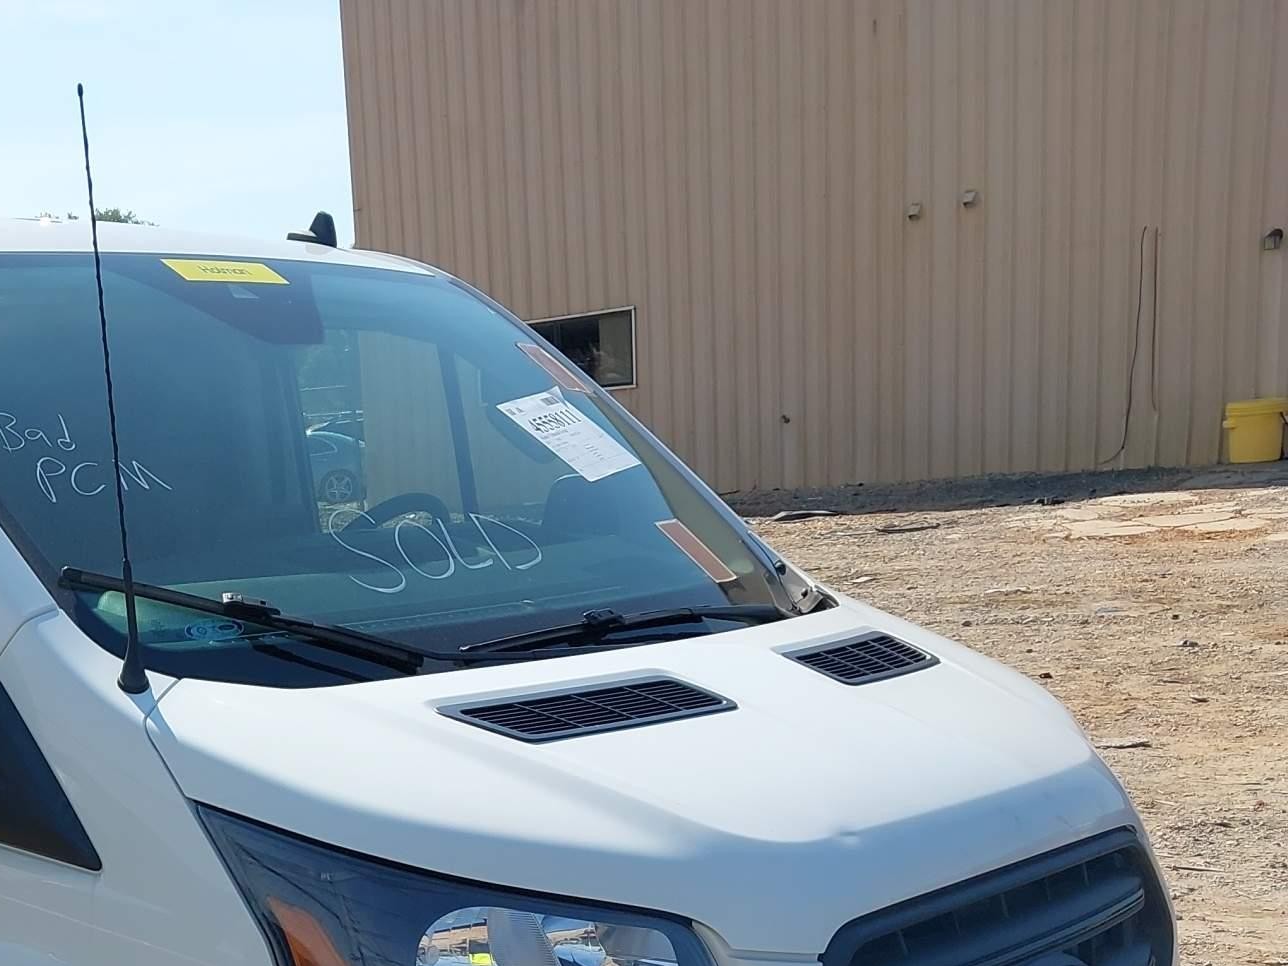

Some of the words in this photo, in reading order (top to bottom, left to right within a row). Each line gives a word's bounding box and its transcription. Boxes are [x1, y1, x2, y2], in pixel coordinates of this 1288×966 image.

[528, 408, 582, 433] 45558111
[36, 456, 173, 503] PCM
[328, 507, 543, 594] SOLD
